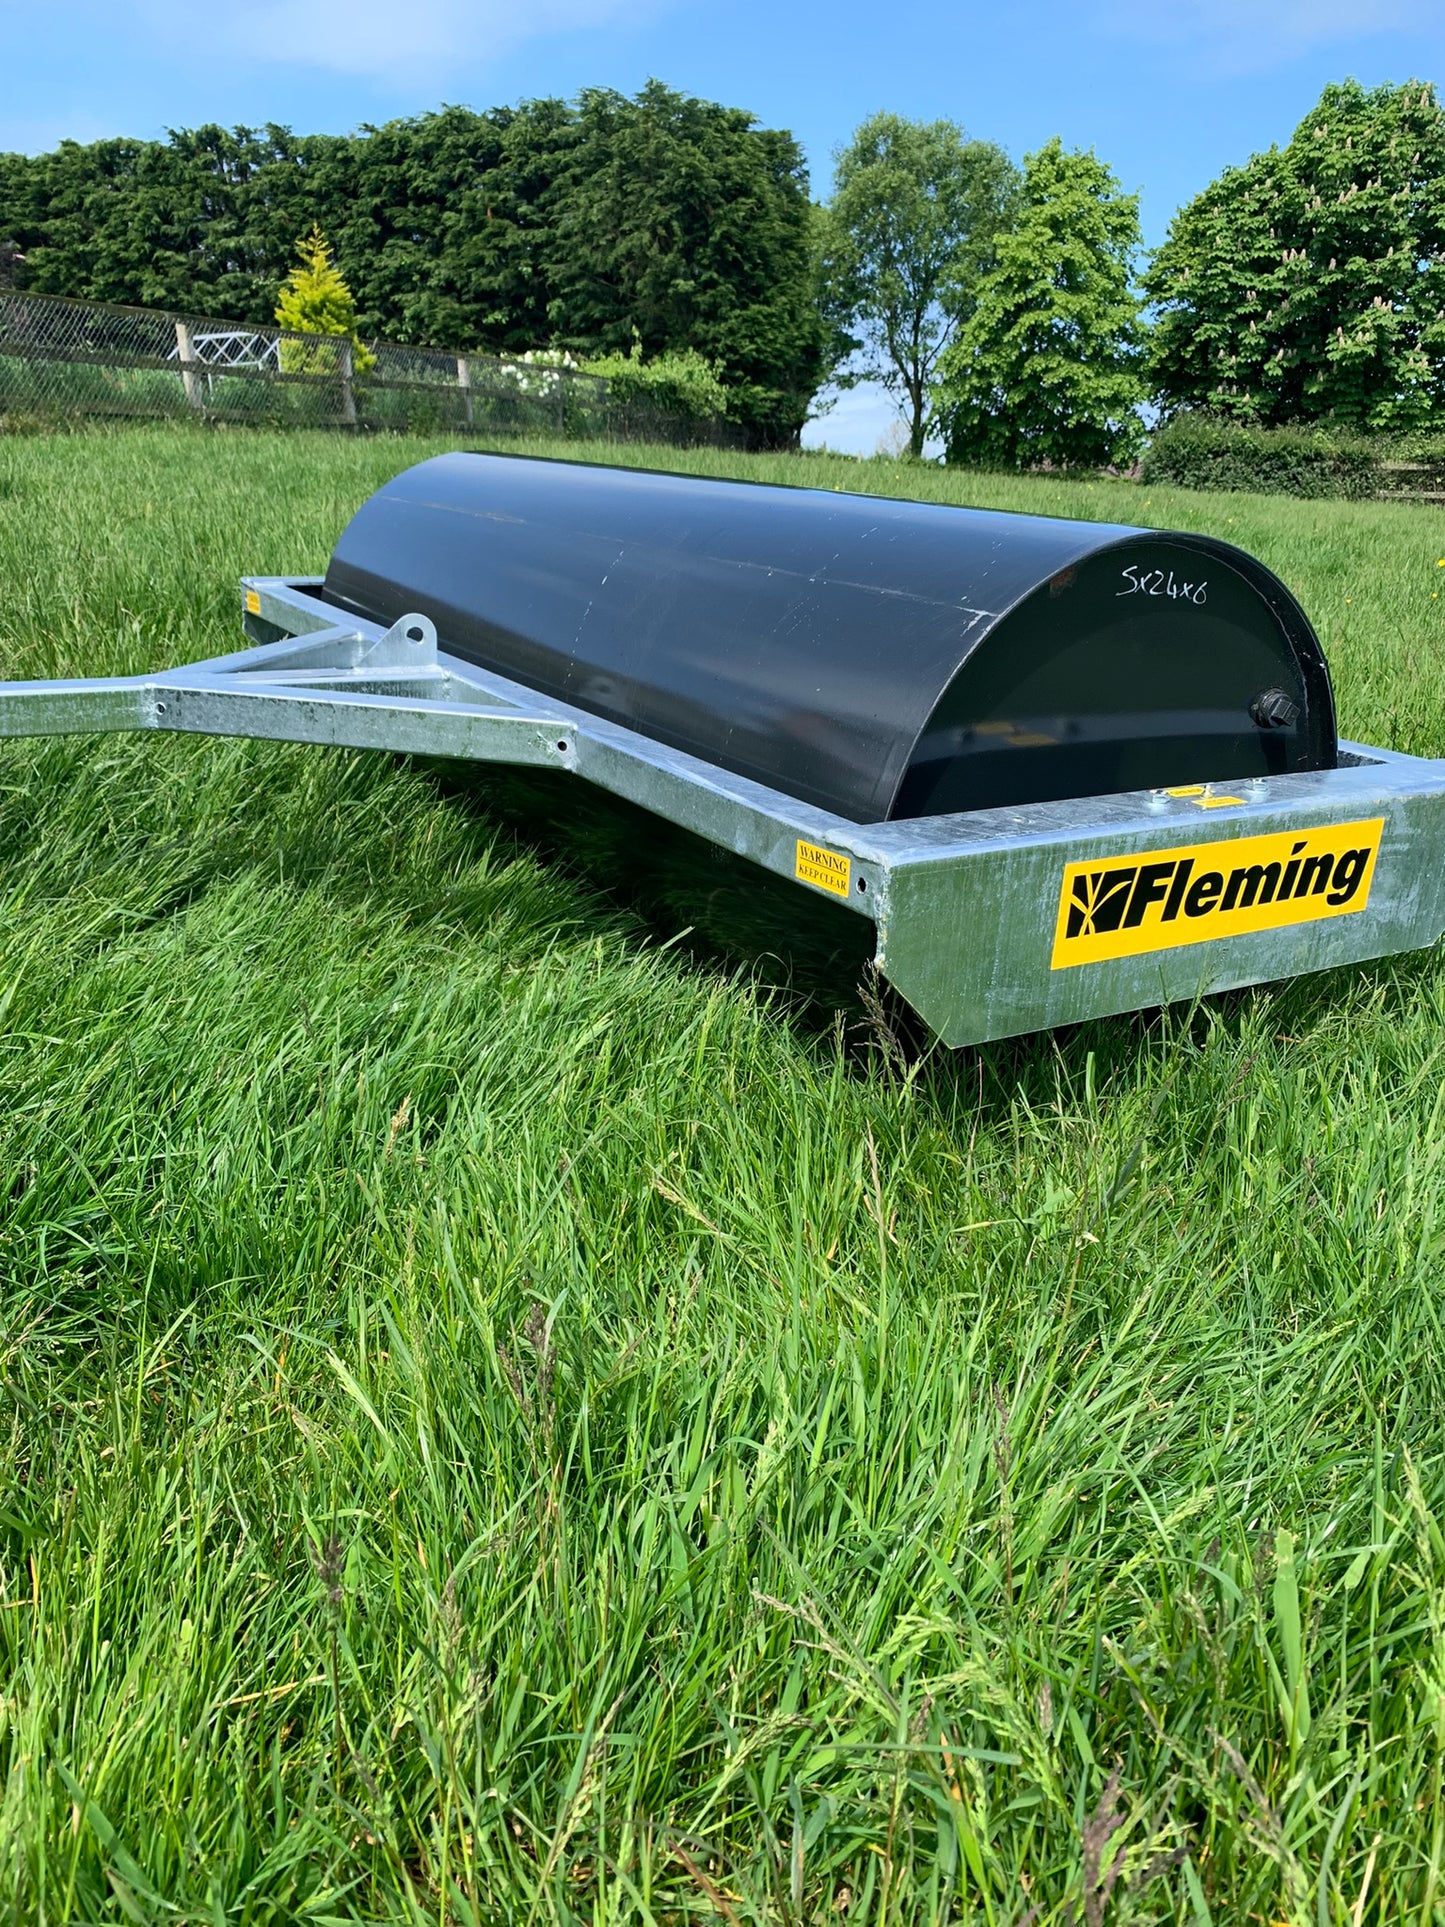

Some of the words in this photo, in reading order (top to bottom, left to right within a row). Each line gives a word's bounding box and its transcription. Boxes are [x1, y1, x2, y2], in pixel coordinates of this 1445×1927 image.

[800, 845, 848, 874] WARNING
[799, 863, 820, 879] KEEP
[819, 871, 847, 891] CLEAR
[1121, 840, 1373, 930] Fleming
